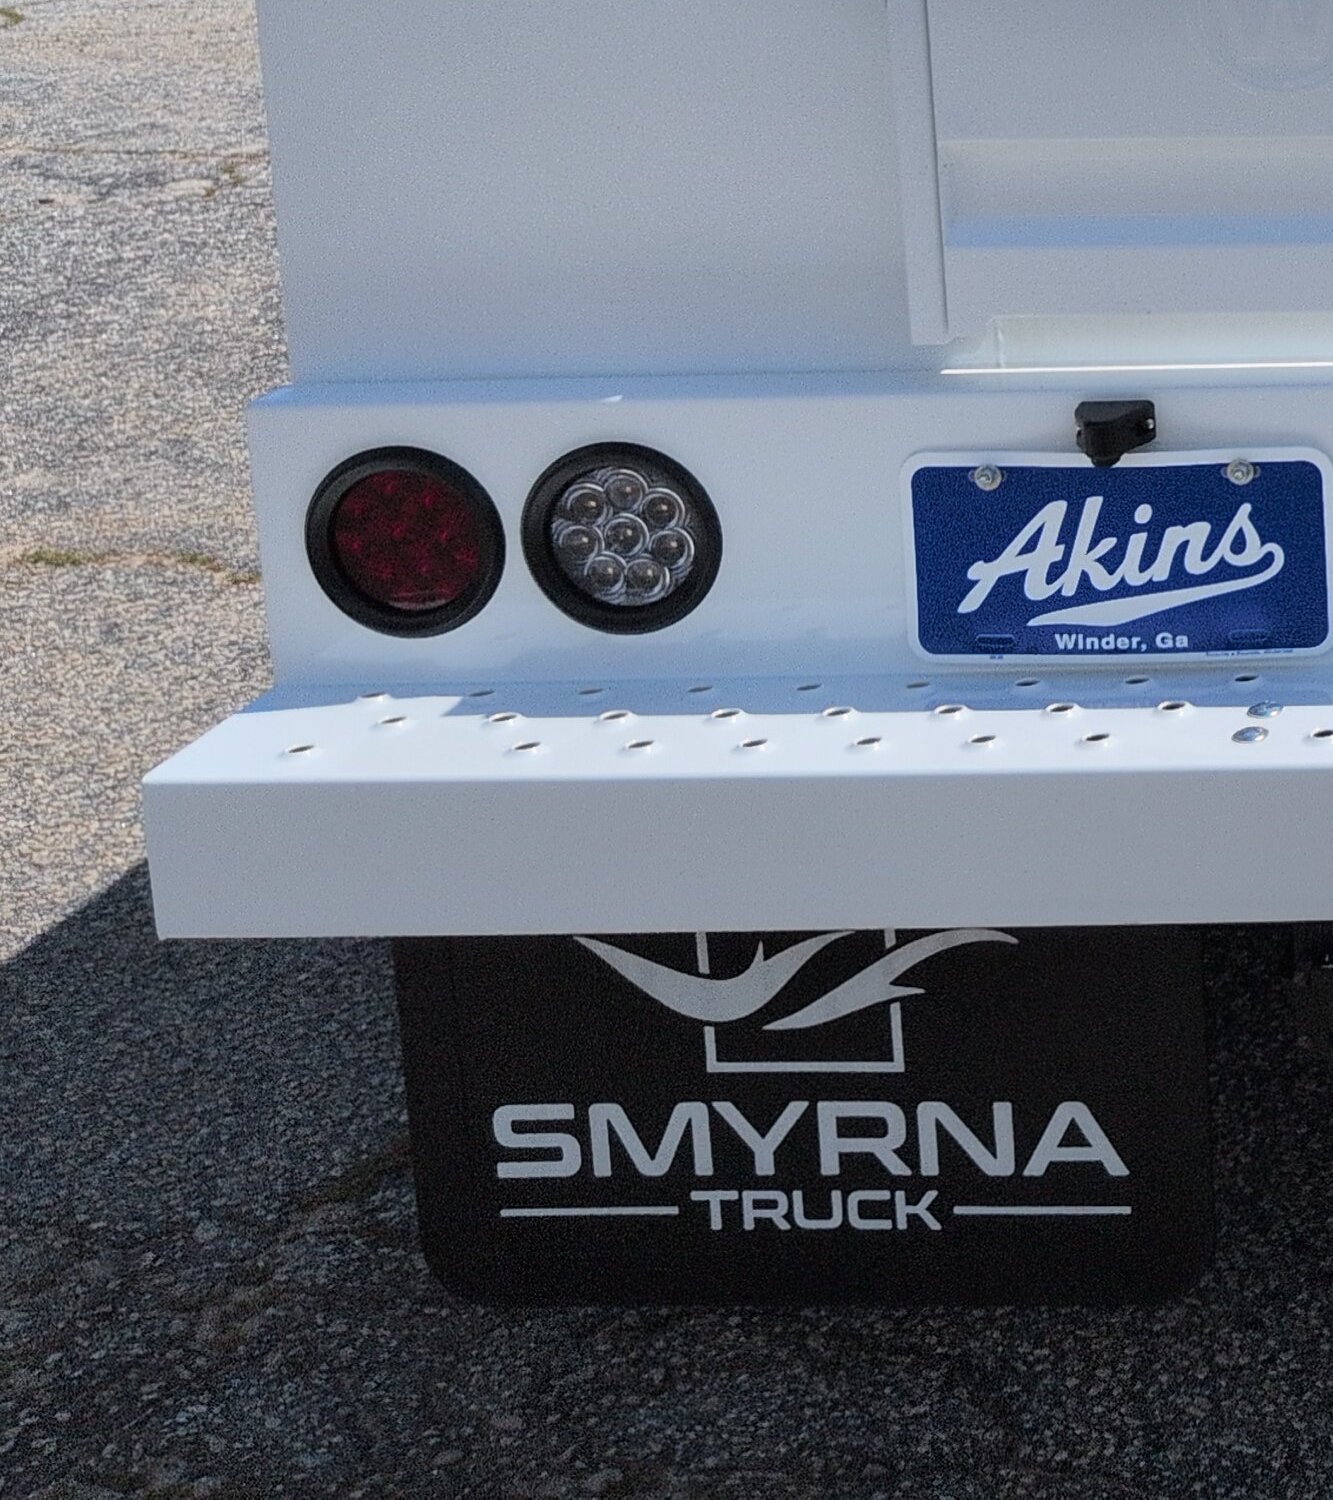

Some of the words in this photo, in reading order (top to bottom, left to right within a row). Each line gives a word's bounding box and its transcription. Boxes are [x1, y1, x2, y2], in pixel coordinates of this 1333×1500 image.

[957, 496, 1285, 626] Akins
[1155, 632, 1189, 648] Ga
[493, 1100, 1130, 1179] SMYRNA
[690, 1189, 942, 1231] TRUCK
